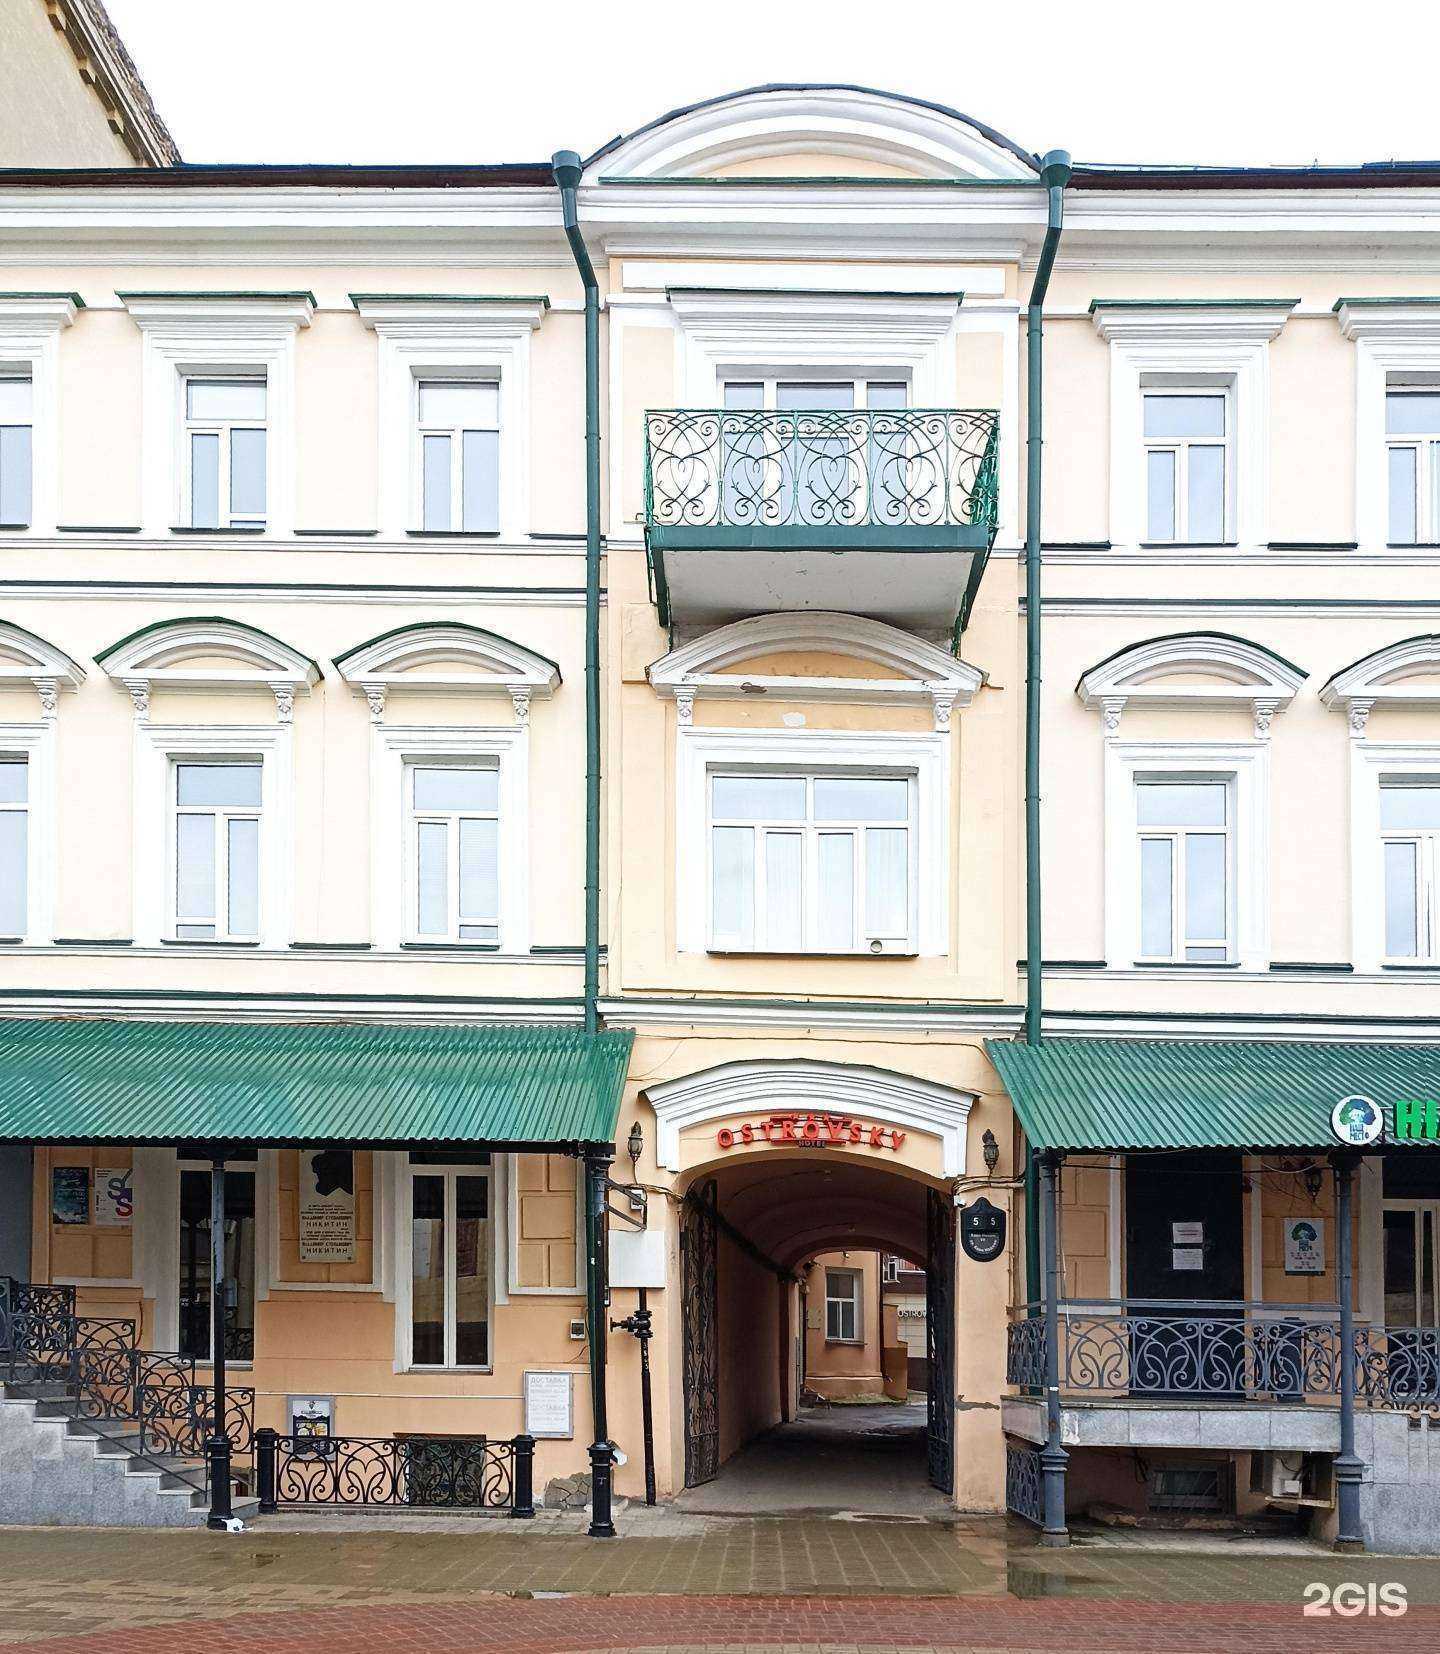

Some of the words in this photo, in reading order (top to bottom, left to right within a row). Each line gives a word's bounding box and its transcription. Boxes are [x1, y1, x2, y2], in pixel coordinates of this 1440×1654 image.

[718, 1119, 906, 1151] OSTROVSKY
[798, 1140, 826, 1148] HOTEL
[973, 1217, 979, 1226] 5
[990, 1217, 996, 1226] 5
